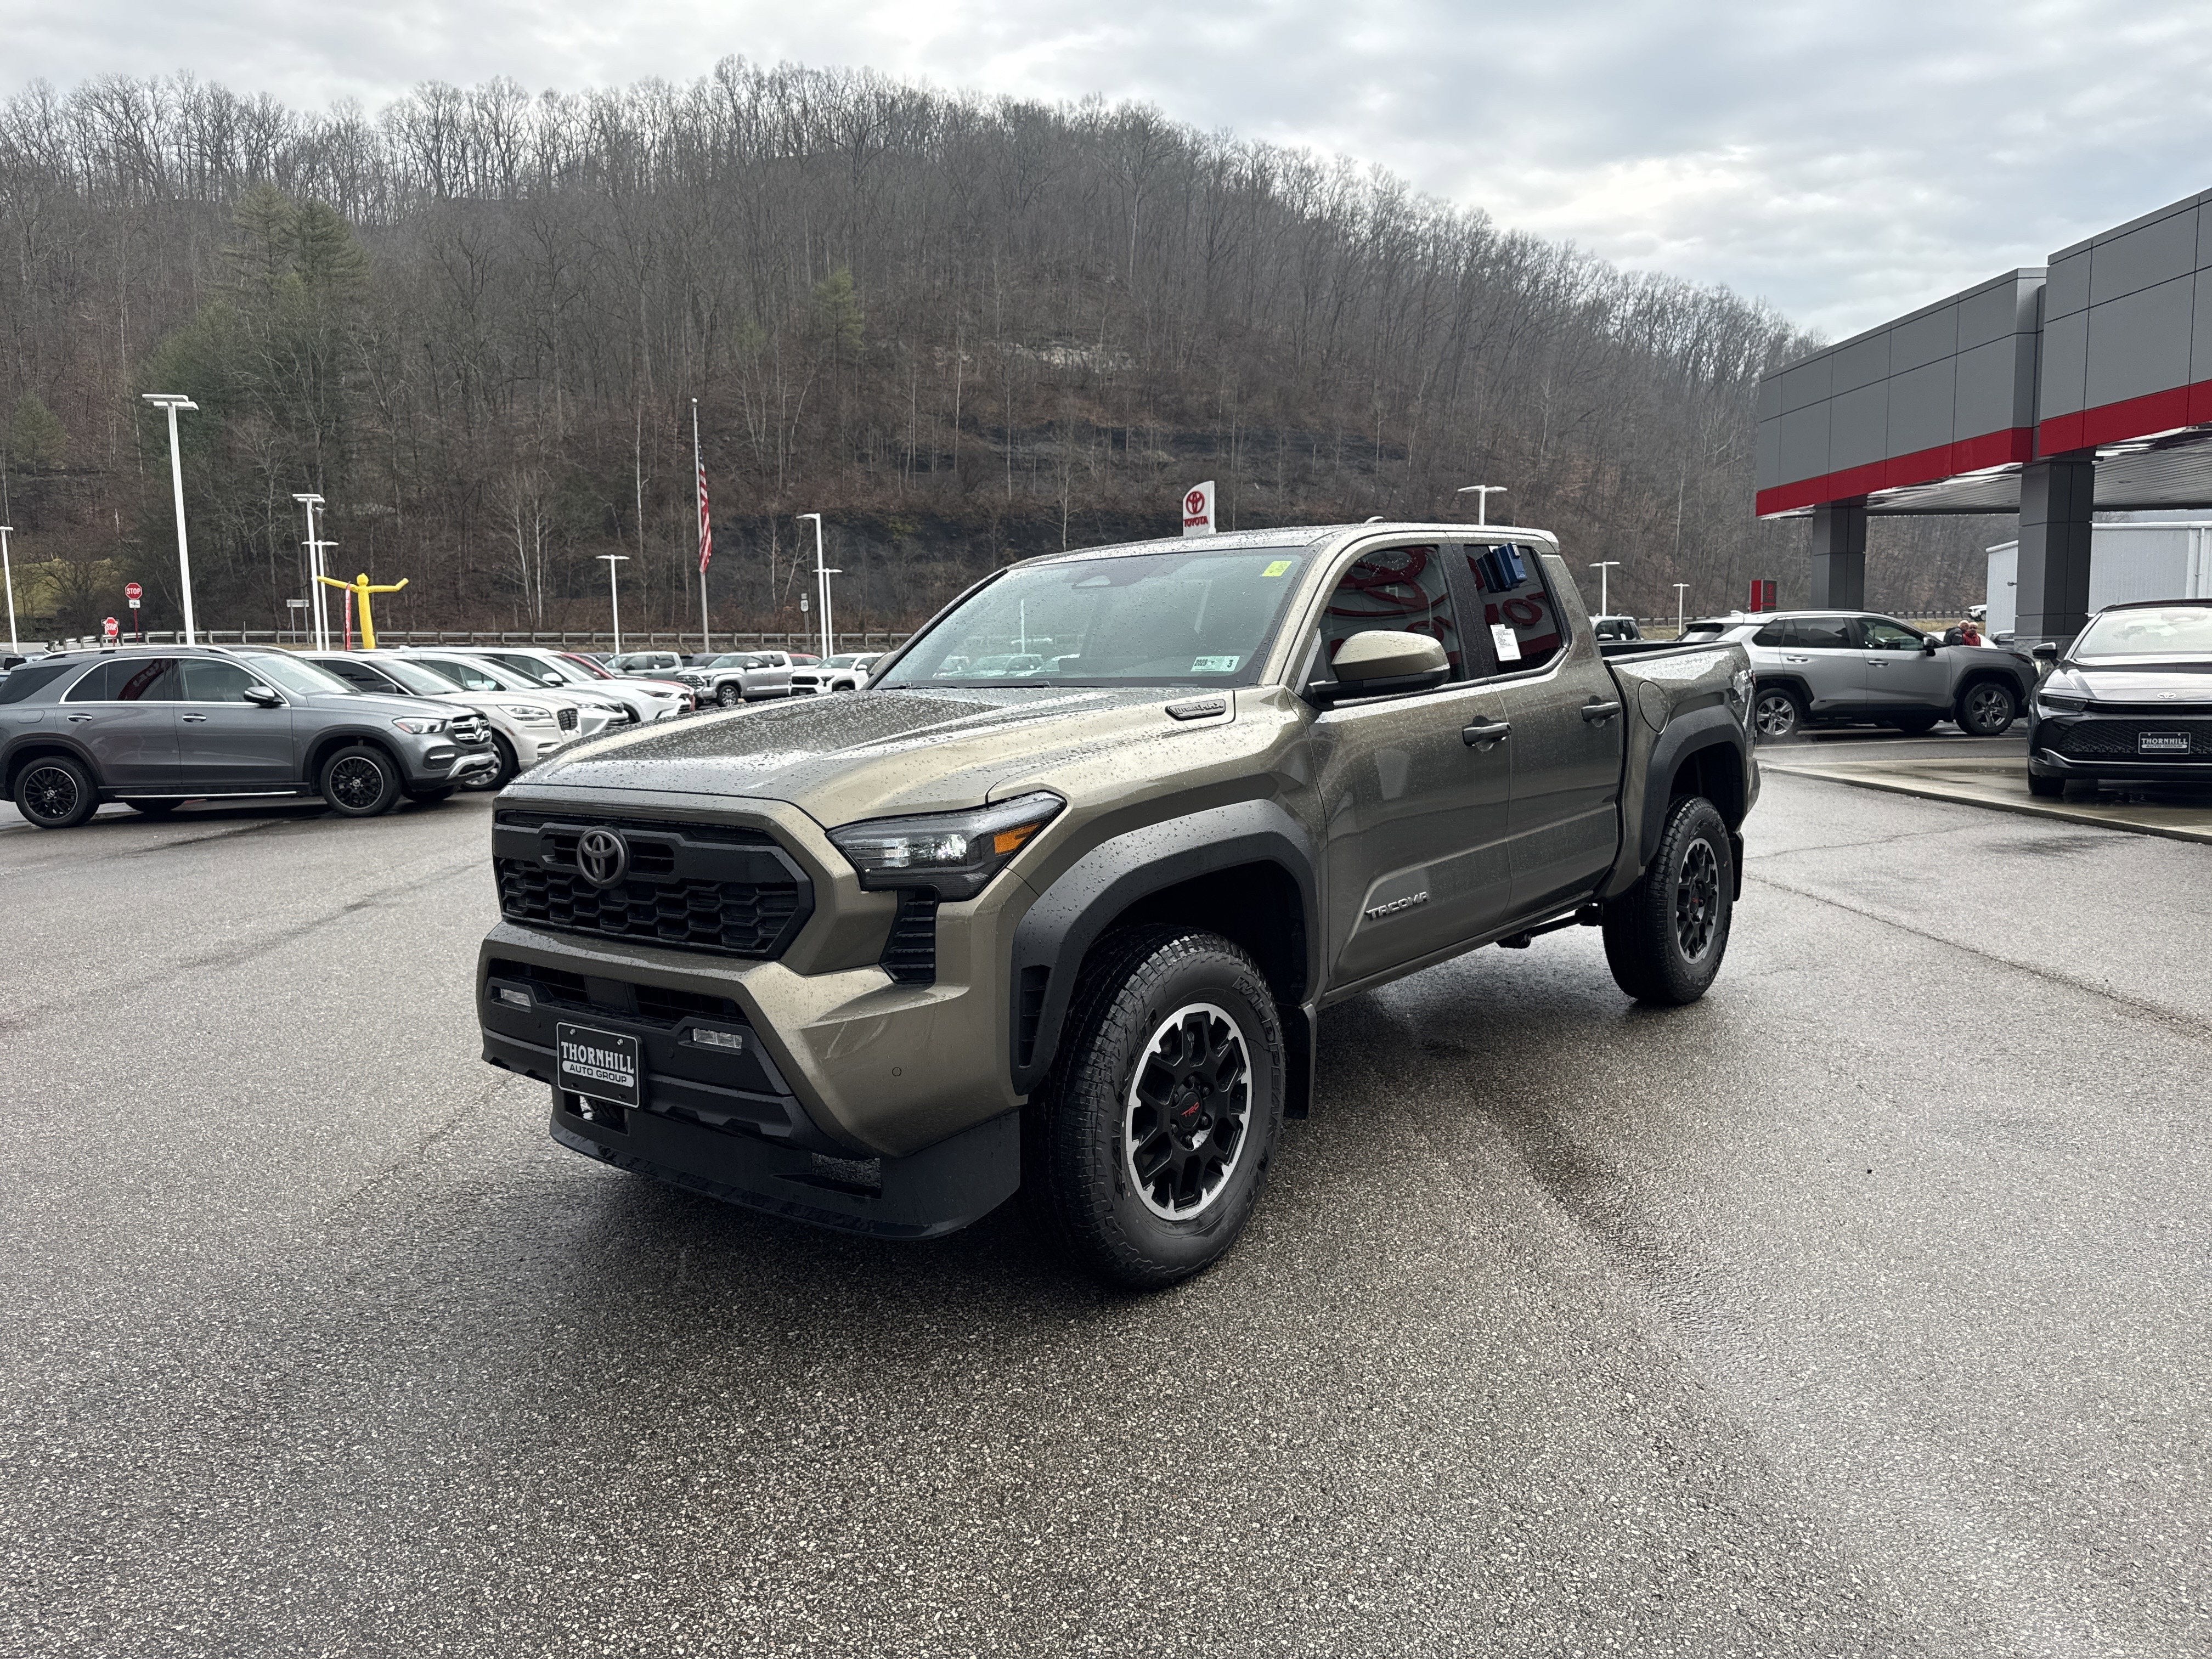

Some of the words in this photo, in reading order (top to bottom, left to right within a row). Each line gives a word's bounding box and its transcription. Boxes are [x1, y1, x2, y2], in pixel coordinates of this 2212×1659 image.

[1183, 516, 1208, 527] TOYOTA
[1227, 659, 1234, 668] 3
[1365, 891, 1430, 919] TACOMA
[561, 1041, 634, 1074] THORNHILL
[1232, 975, 1282, 1139] WILDPEAK
[569, 1064, 593, 1076] AUTO
[596, 1070, 627, 1083] GROUP
[1181, 1102, 1199, 1118] TRD
